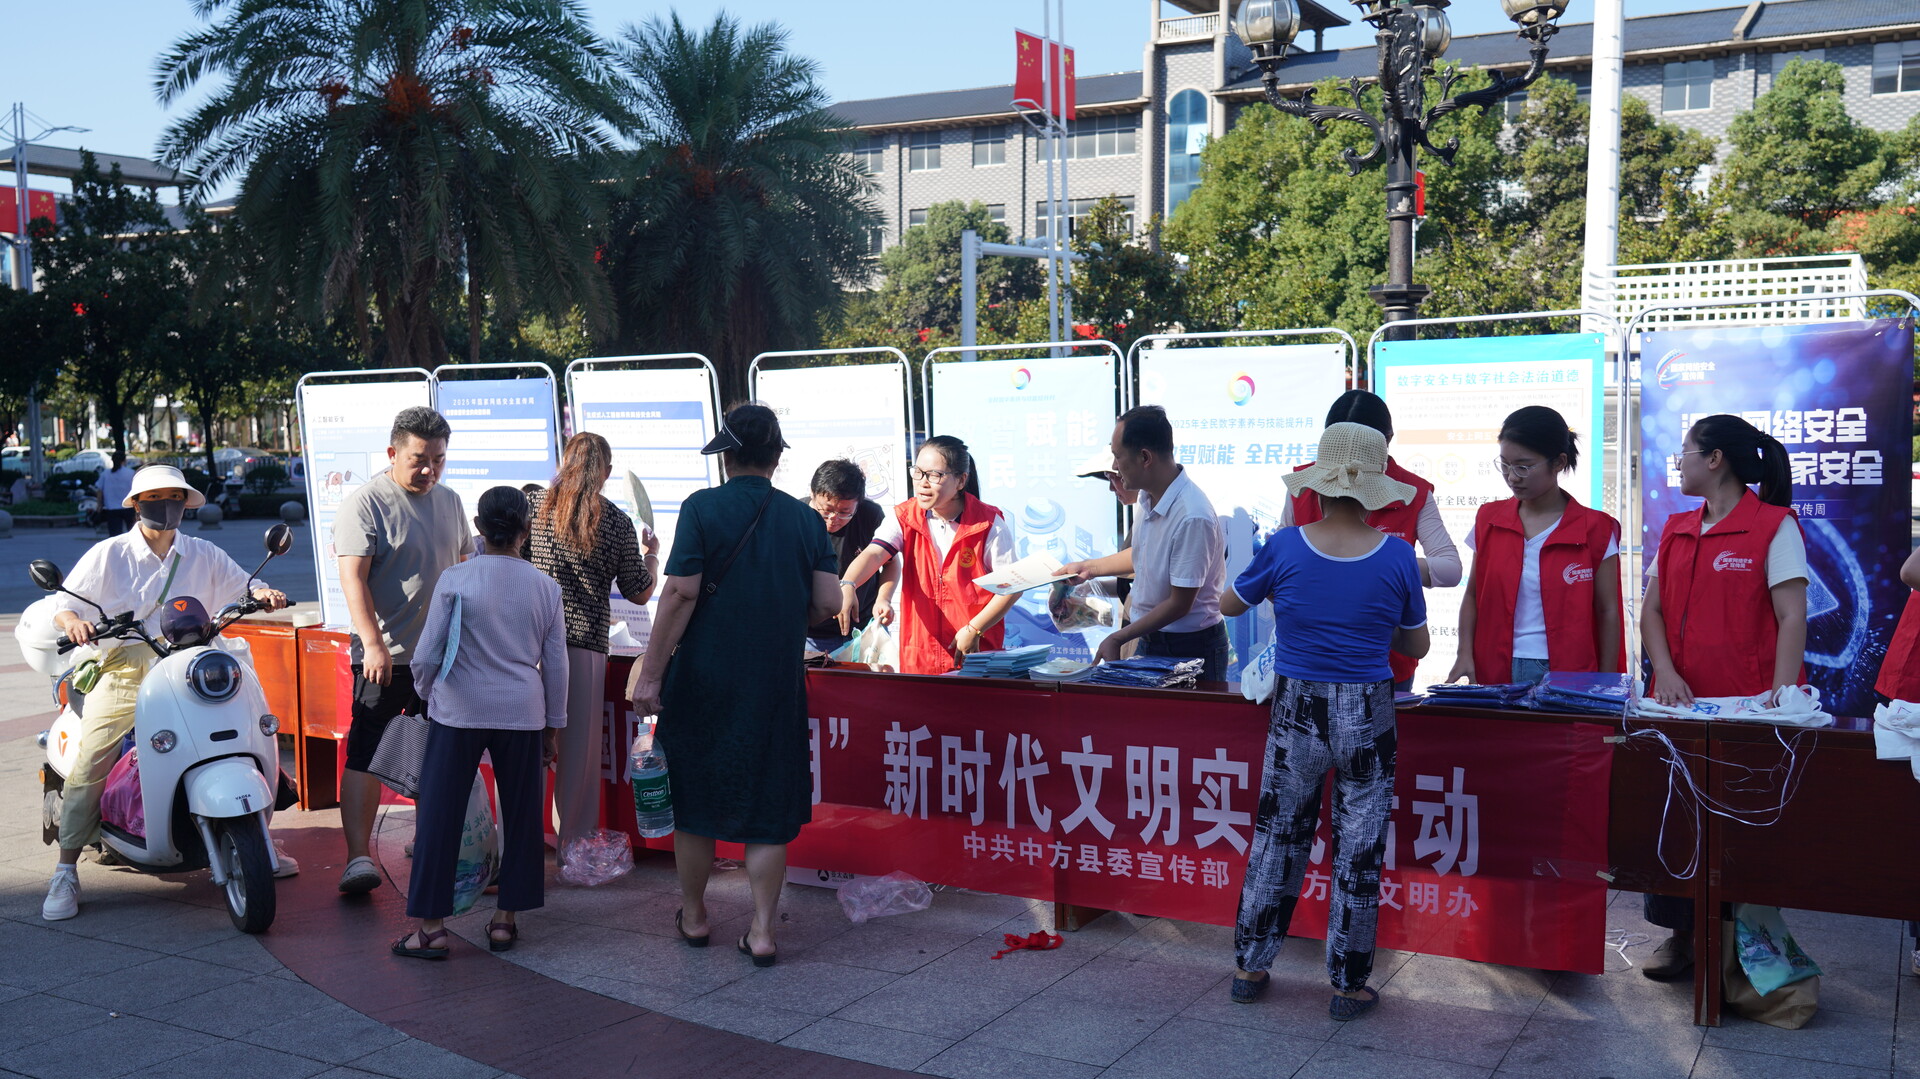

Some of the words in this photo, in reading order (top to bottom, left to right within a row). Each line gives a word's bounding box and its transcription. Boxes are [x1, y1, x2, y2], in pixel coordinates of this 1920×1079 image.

[1671, 361, 1716, 373] 国家网络安全
[1681, 371, 1705, 381] 宣传周
[1397, 368, 1580, 387] 数字安全与数字社会法治道德
[1174, 443, 1236, 465] 智赋能
[1435, 495, 1511, 506] 于全民数字
[883, 721, 1480, 878] 新时代文明实动
[962, 830, 1231, 889] 中共中方县委宣传部
